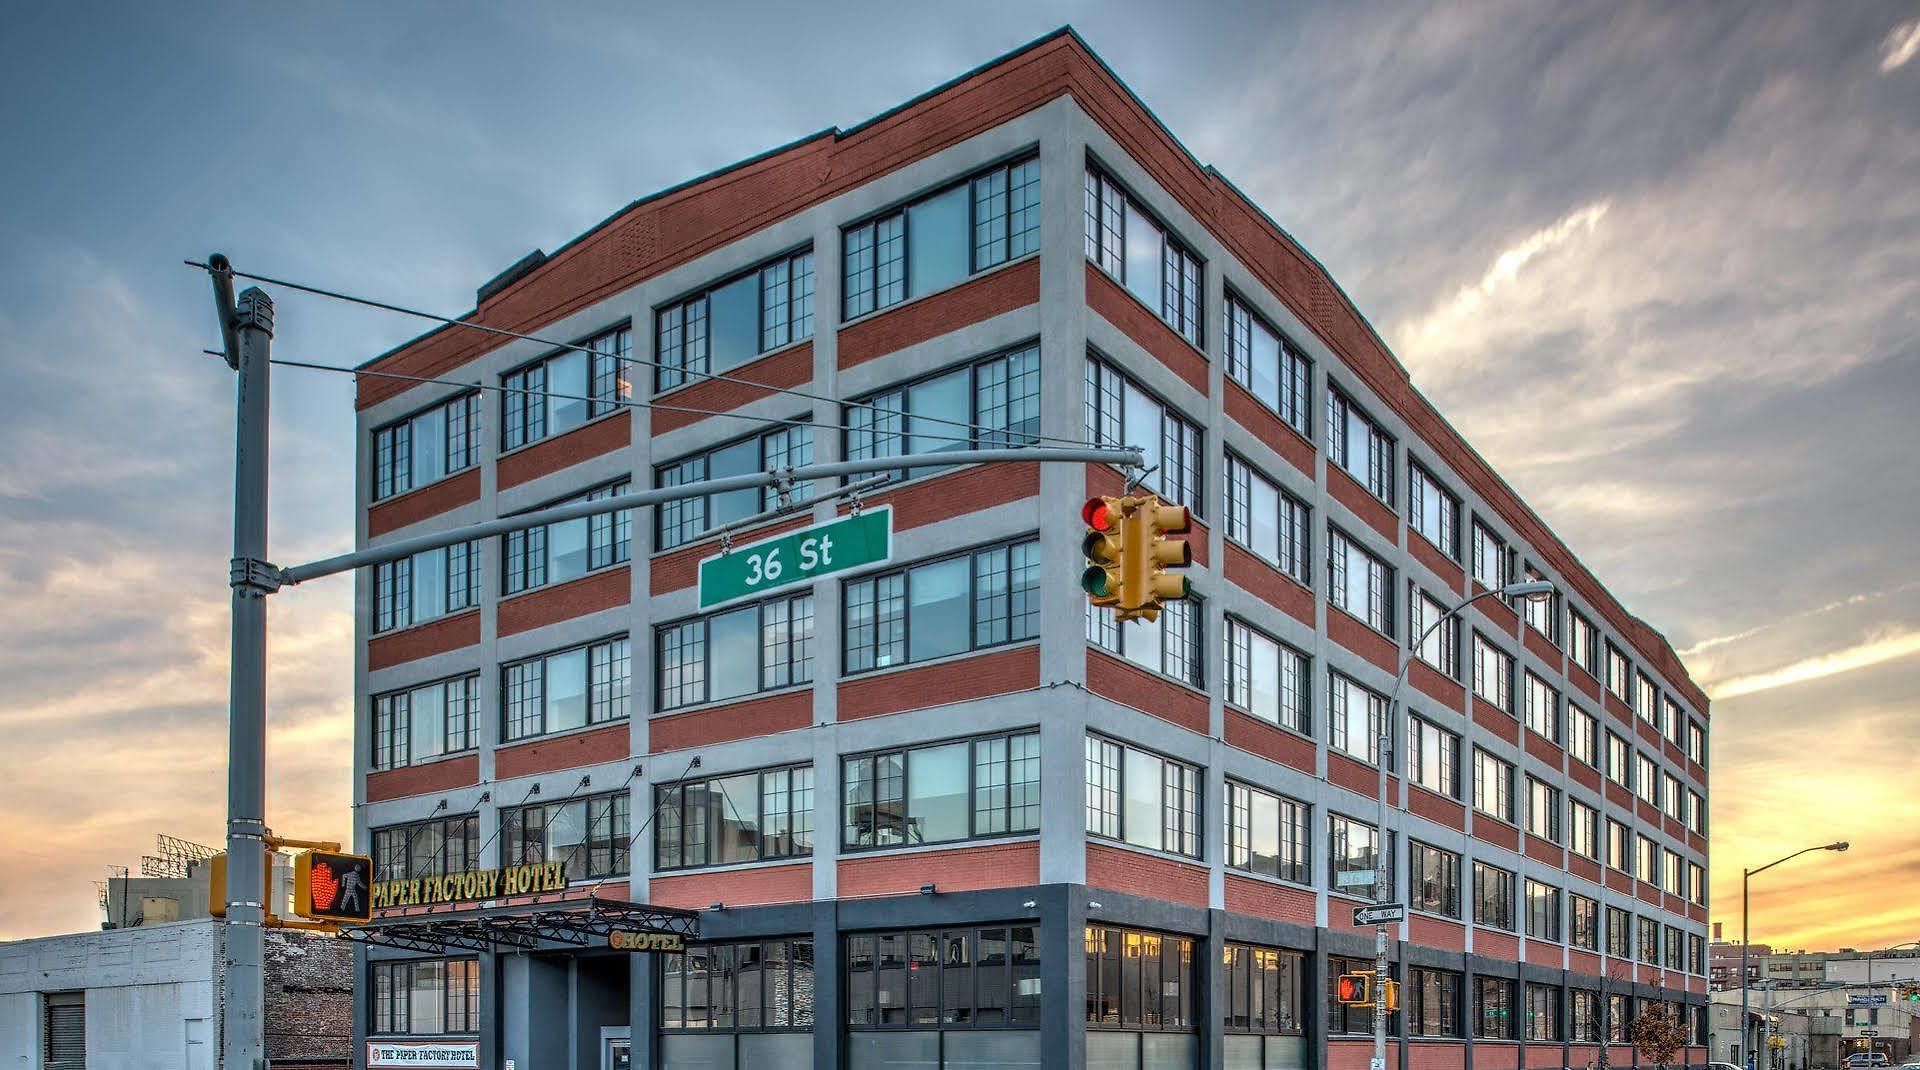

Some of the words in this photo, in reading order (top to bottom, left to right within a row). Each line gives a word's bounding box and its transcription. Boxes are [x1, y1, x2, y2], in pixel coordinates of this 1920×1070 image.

[745, 547, 783, 586] 36
[799, 534, 833, 571] St
[372, 879, 421, 908] PAPER
[423, 869, 499, 903] FACTORY
[503, 862, 566, 895] HOTEL
[1359, 911, 1373, 920] ONE
[1380, 909, 1396, 919] WAY
[623, 932, 685, 951] HOTEL
[381, 1049, 394, 1060] THE
[396, 1049, 418, 1060] PAPER
[419, 1050, 451, 1061] FACTORY
[451, 1050, 475, 1061] HOTEL
